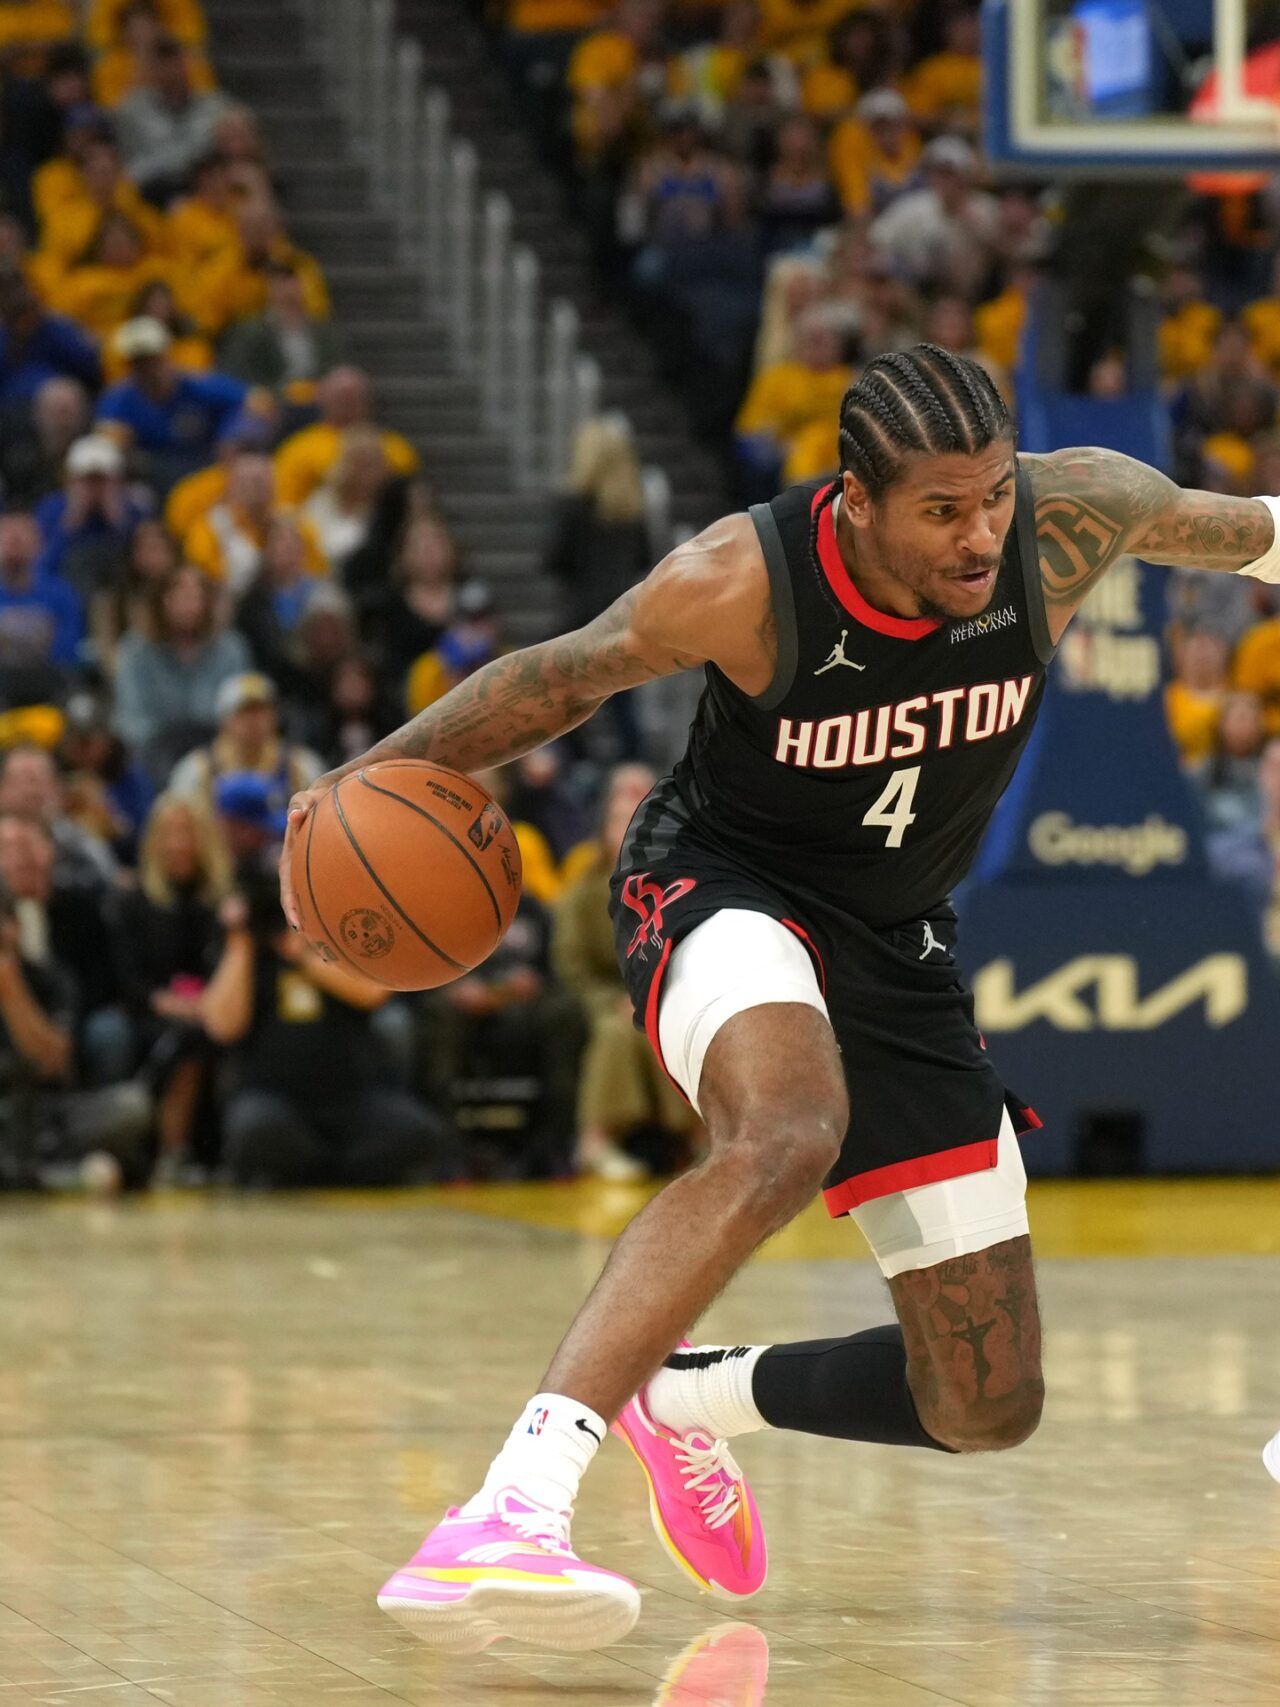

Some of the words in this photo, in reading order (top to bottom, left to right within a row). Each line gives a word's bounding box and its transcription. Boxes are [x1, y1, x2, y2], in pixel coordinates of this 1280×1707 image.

[950, 612, 1017, 645] HERMANN
[951, 605, 1017, 636] MEMORIAL
[774, 674, 1034, 769] HOUSTON
[861, 765, 922, 849] 4
[1028, 811, 1188, 876] Google
